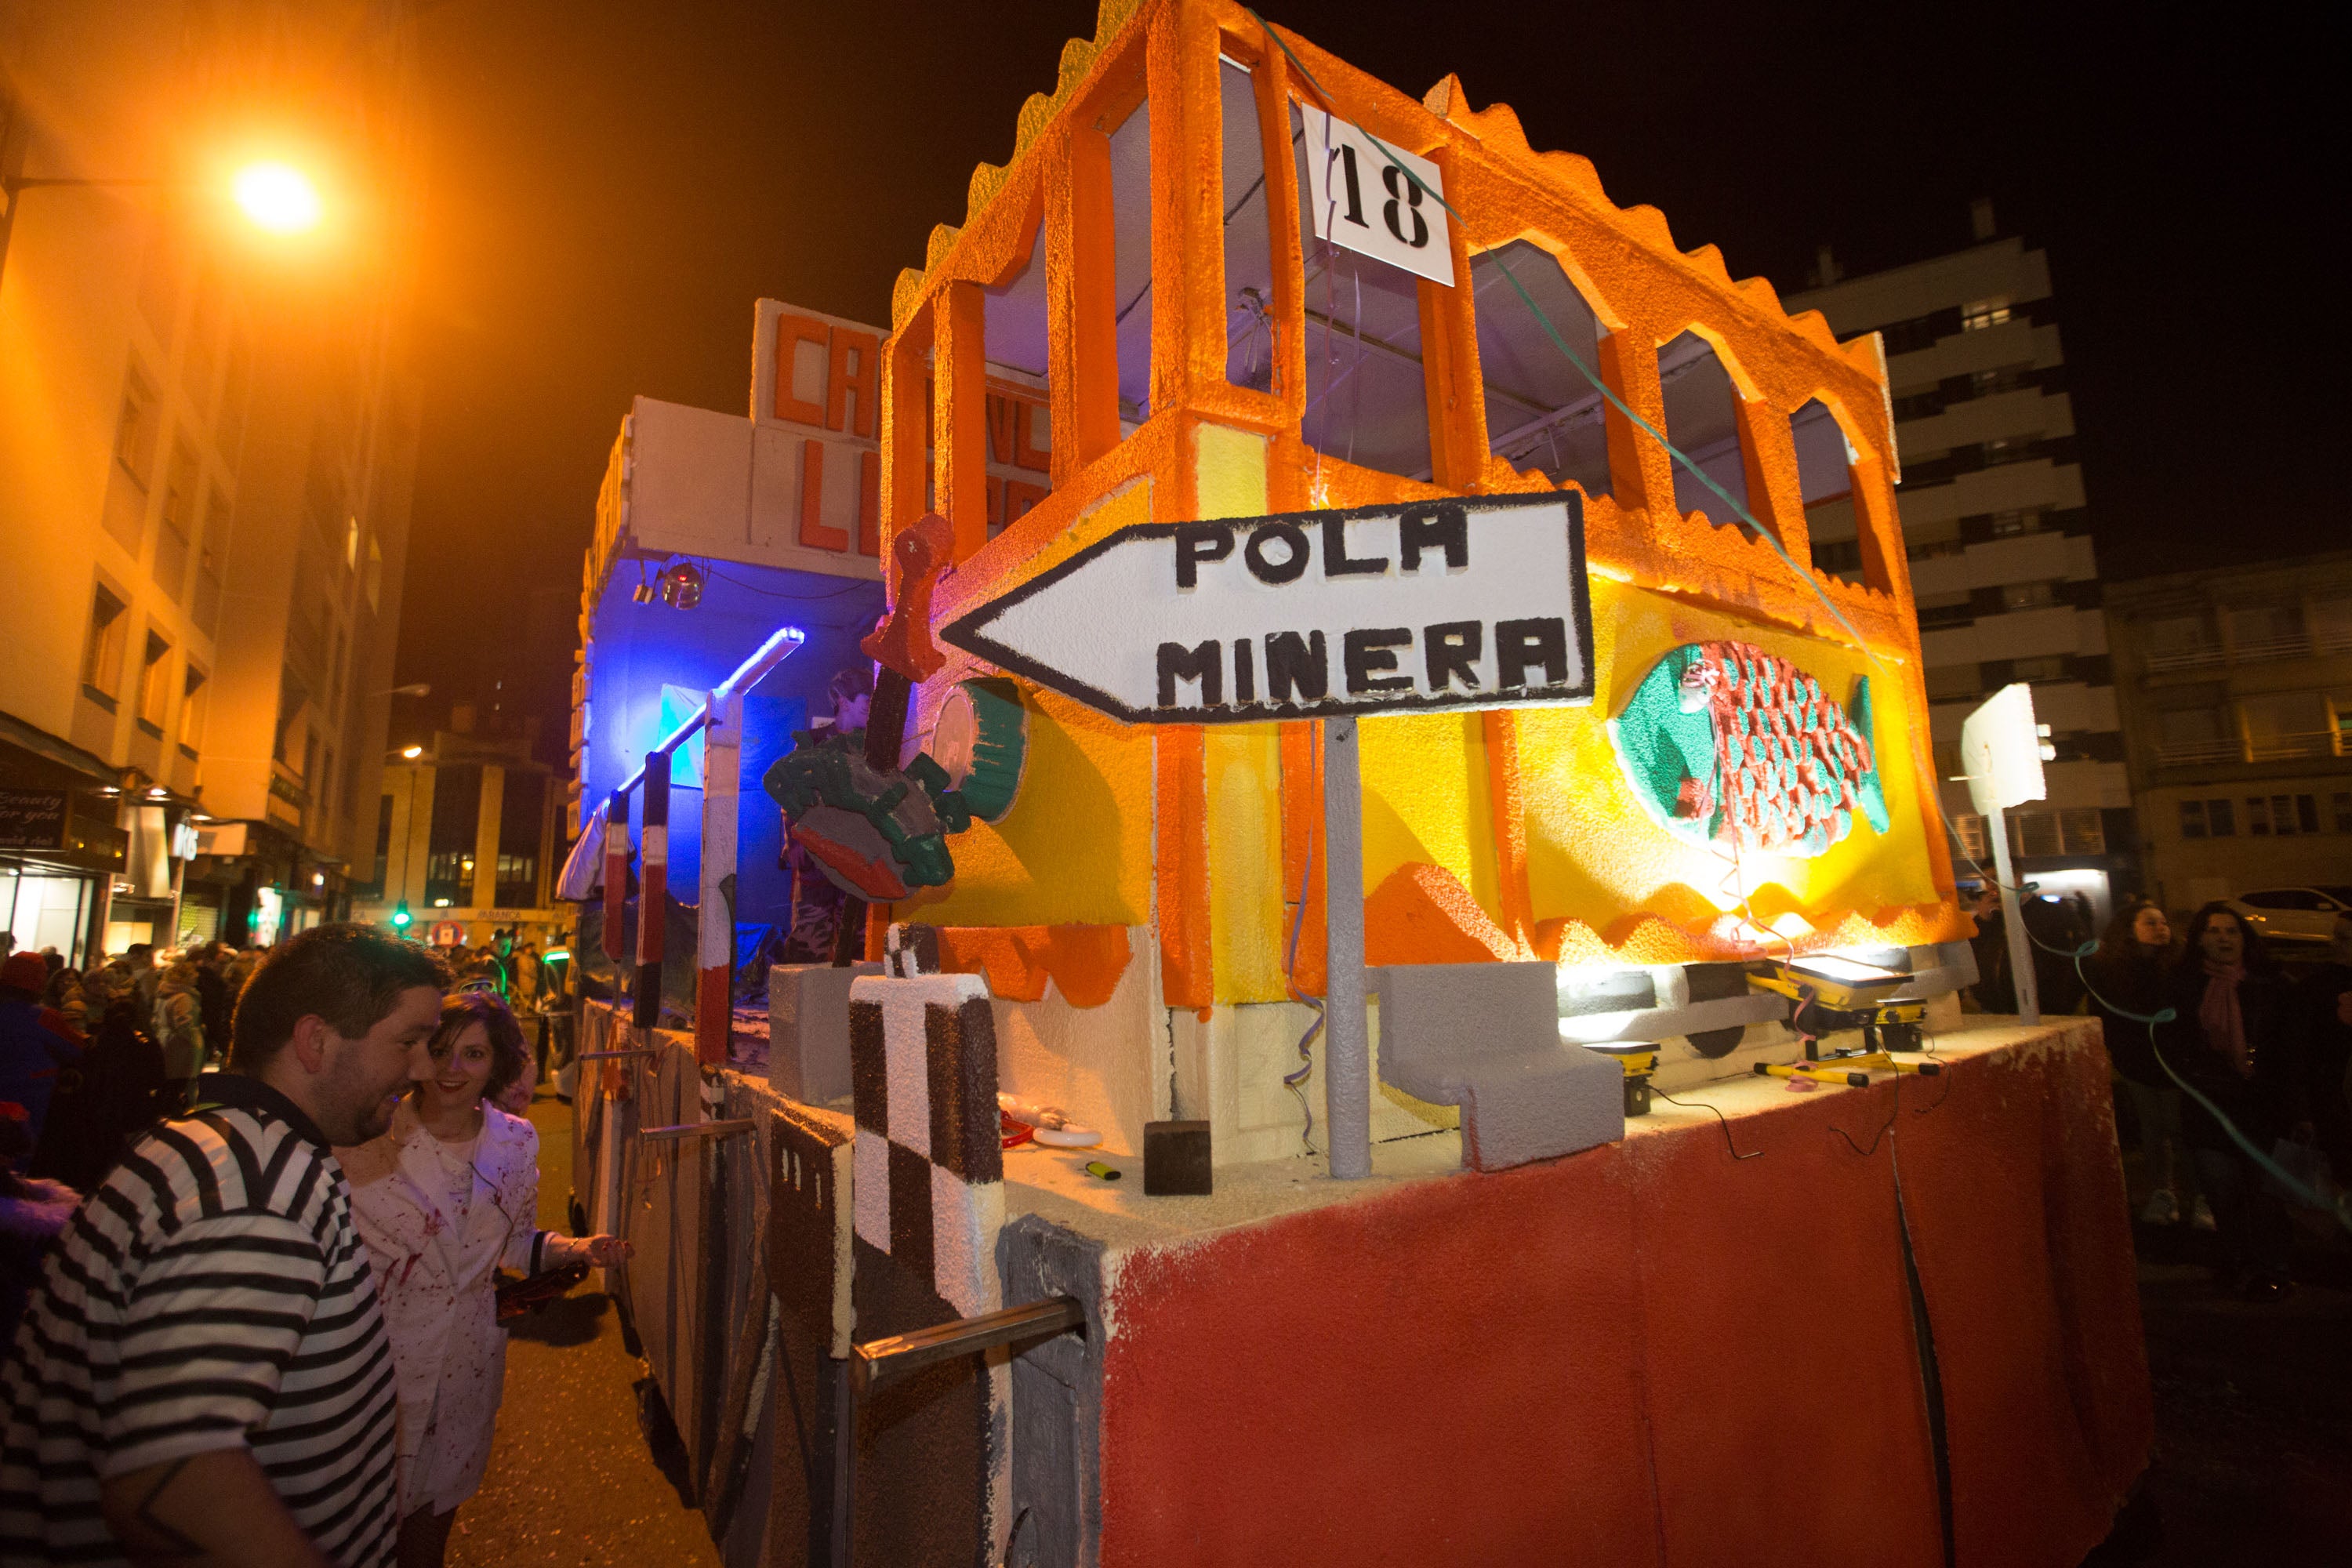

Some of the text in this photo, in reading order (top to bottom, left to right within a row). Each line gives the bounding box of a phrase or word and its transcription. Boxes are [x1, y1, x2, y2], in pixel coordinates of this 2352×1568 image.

[1333, 143, 1429, 248] 18
[1176, 503, 1469, 591] POLA
[1156, 617, 1568, 708] MINERA
